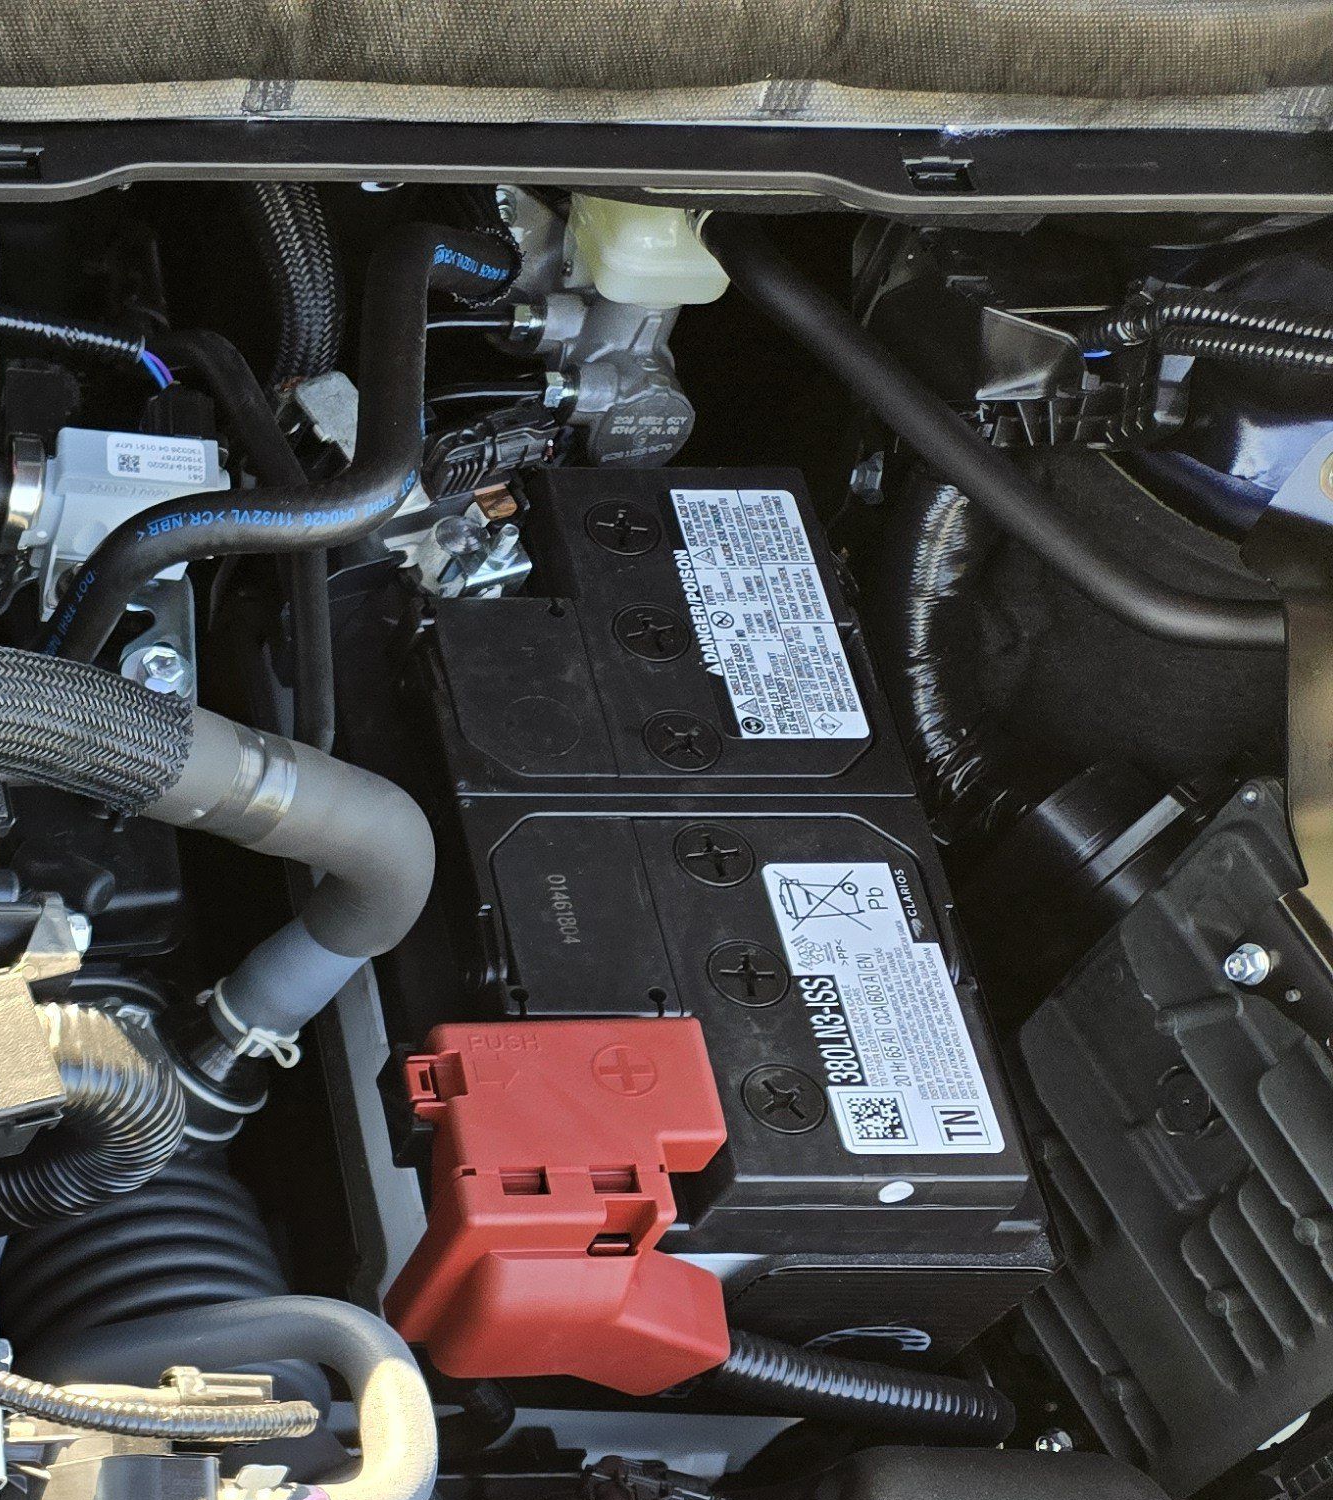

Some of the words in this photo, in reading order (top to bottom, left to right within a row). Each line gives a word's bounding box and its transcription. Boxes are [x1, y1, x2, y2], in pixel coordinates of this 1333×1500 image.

[672, 549, 720, 662] DANGER/POISON
[862, 886, 889, 908] Pb
[893, 868, 918, 916] CLARIOS
[547, 874, 581, 944] 01461804
[853, 952, 877, 971] (EN)
[863, 984, 884, 1002] 603
[870, 1005, 892, 1024] CCA
[796, 976, 864, 1082] 380LN3-ISS
[878, 1030, 898, 1043] Ah
[883, 1046, 903, 1057] 65
[888, 1061, 907, 1072] Hr
[893, 1074, 912, 1086] 20
[938, 1110, 985, 1140] TN
